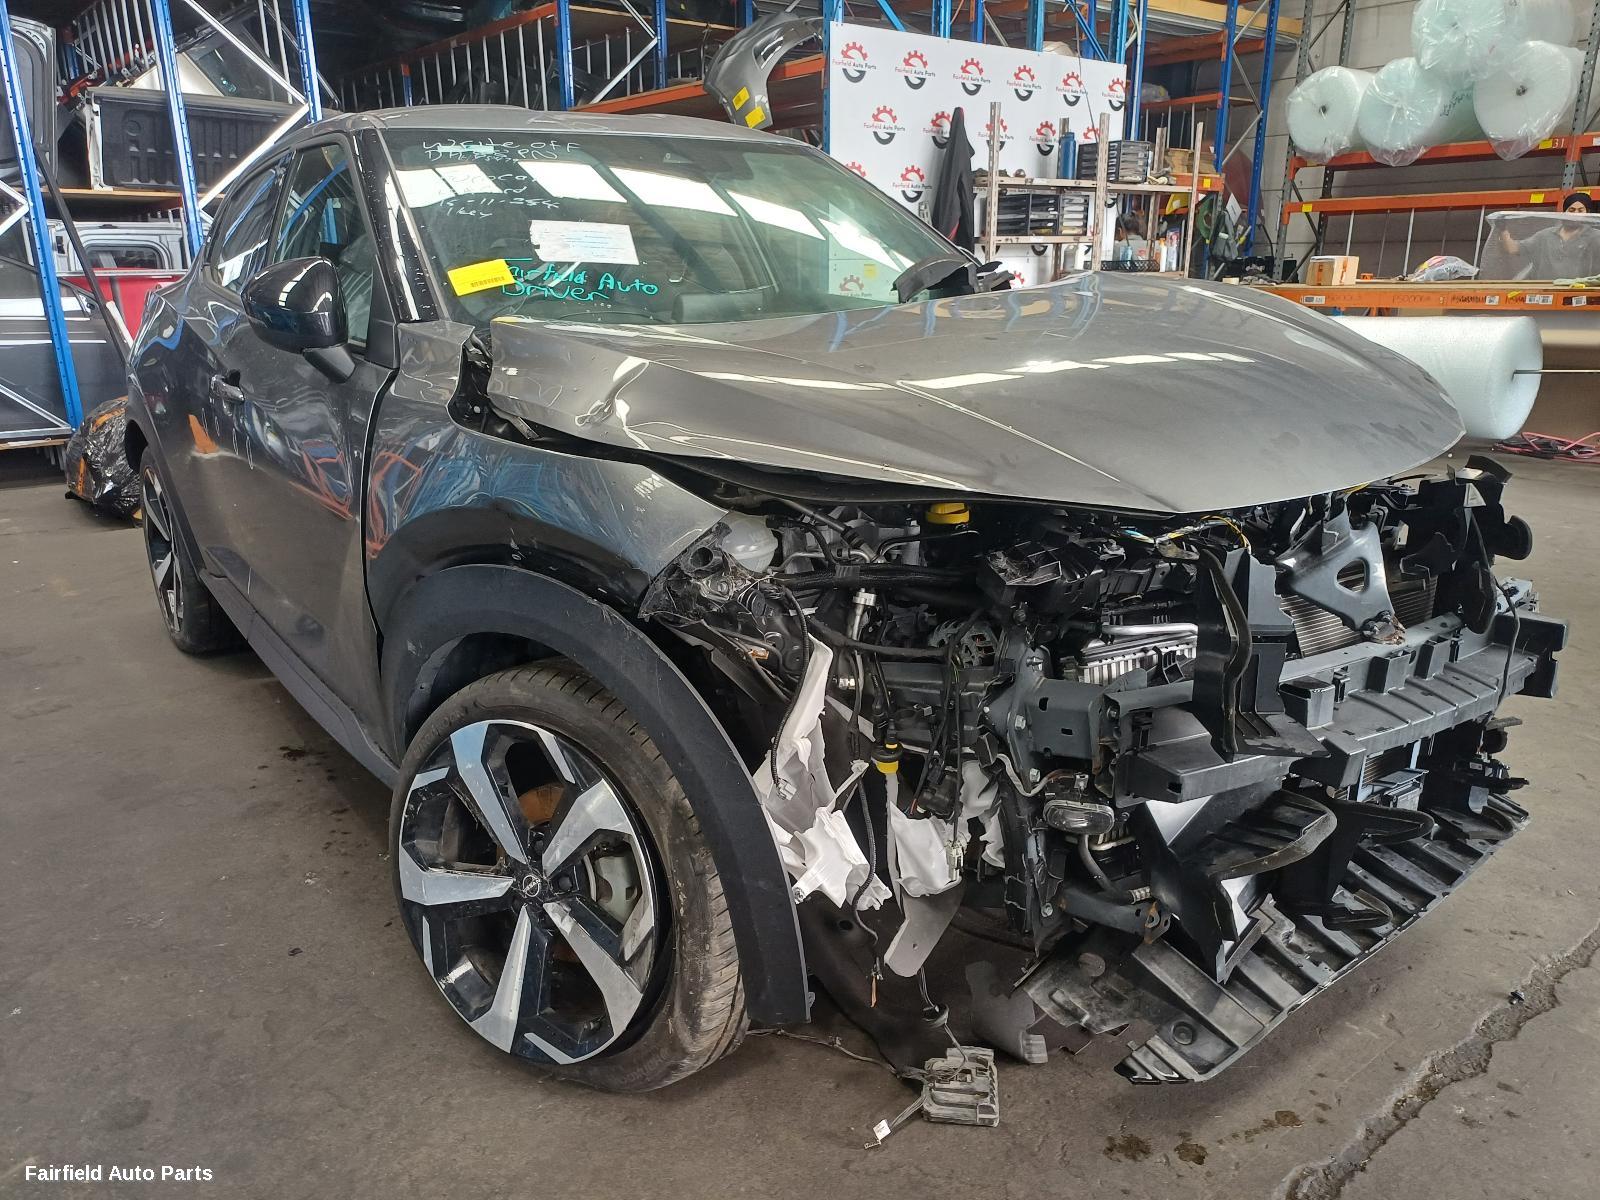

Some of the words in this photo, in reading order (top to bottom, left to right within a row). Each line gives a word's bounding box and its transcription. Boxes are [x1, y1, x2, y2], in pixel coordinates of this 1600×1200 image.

[832, 58, 852, 67] Fairfield
[894, 66, 913, 75] Fairfield
[863, 122, 881, 130] Fairfield
[598, 272, 659, 295] Auto
